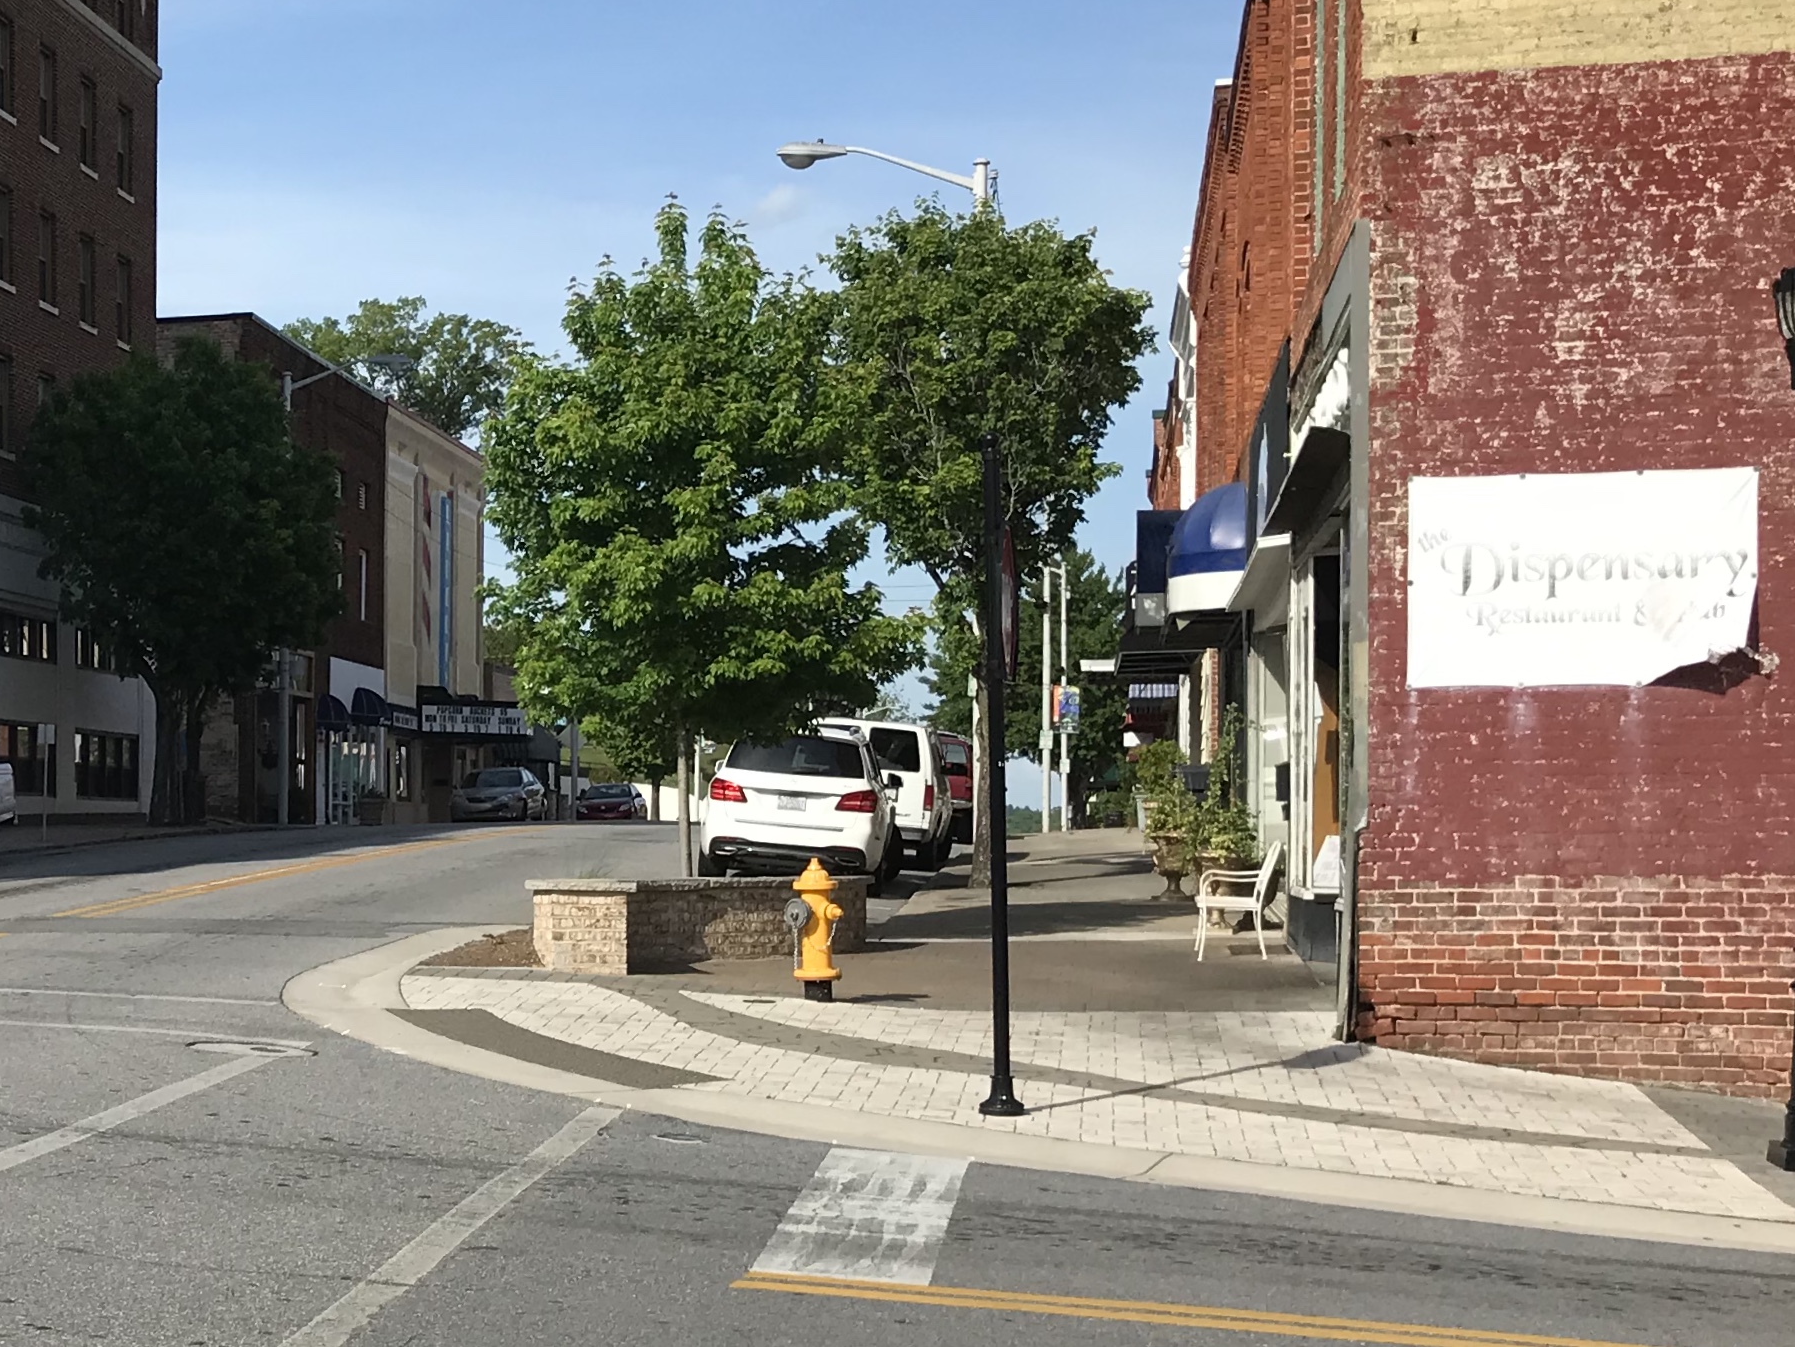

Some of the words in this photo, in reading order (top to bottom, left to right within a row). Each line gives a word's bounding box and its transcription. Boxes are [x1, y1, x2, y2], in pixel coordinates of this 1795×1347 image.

[1417, 528, 1452, 553] the
[1440, 541, 1749, 600] Dispensary
[1465, 601, 1622, 637] Restaurant
[461, 715, 491, 724] SATURDAY
[498, 716, 520, 725] SUNDAY
